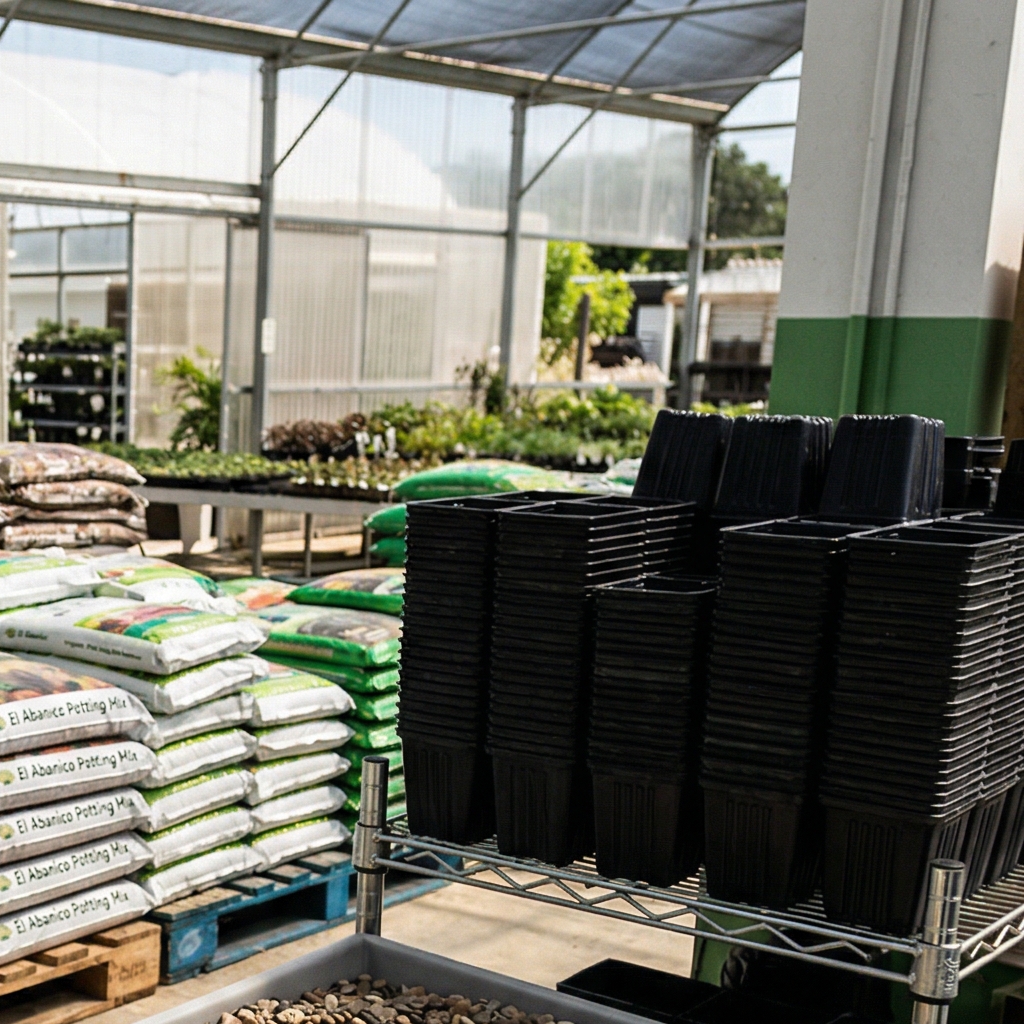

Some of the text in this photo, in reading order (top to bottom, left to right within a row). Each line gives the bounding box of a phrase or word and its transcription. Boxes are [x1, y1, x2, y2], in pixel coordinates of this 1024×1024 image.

[8, 711, 21, 726] El
[17, 765, 29, 781] El
[31, 757, 76, 777] Abanico
[16, 818, 28, 835] El
[14, 870, 26, 886] El
[28, 860, 71, 882] Abanico
[13, 918, 25, 935] El
[28, 908, 71, 932] Abanico
